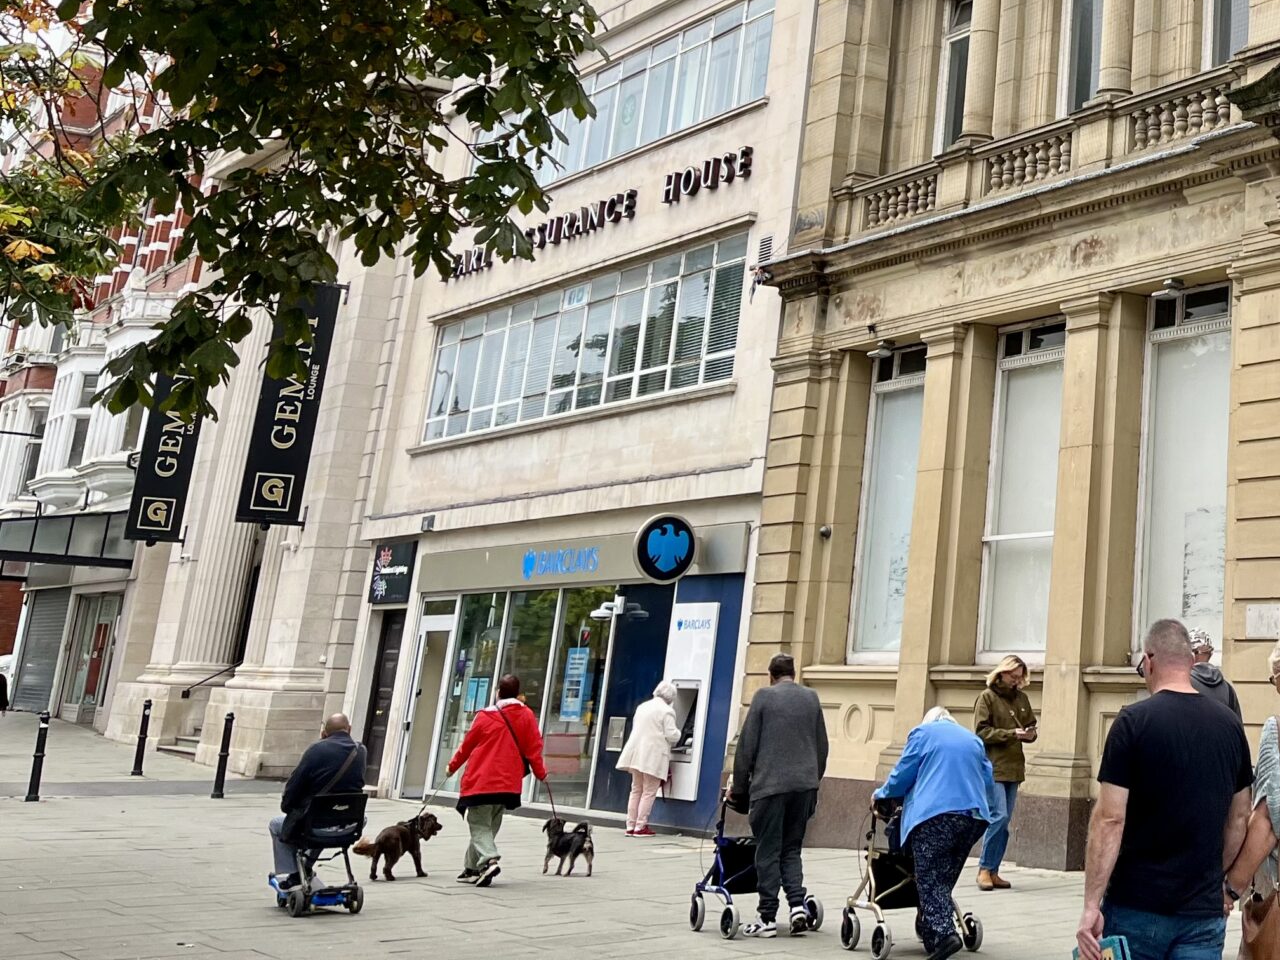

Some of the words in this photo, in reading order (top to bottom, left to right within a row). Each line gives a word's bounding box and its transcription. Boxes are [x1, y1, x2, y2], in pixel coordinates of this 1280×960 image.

[450, 244, 494, 279] ARL
[512, 189, 638, 258] SURANCE
[662, 146, 754, 205] HOUSE
[306, 364, 320, 400] LOUNGE
[537, 547, 599, 575] BARCLAYS
[683, 619, 711, 631] BARCLAYS
